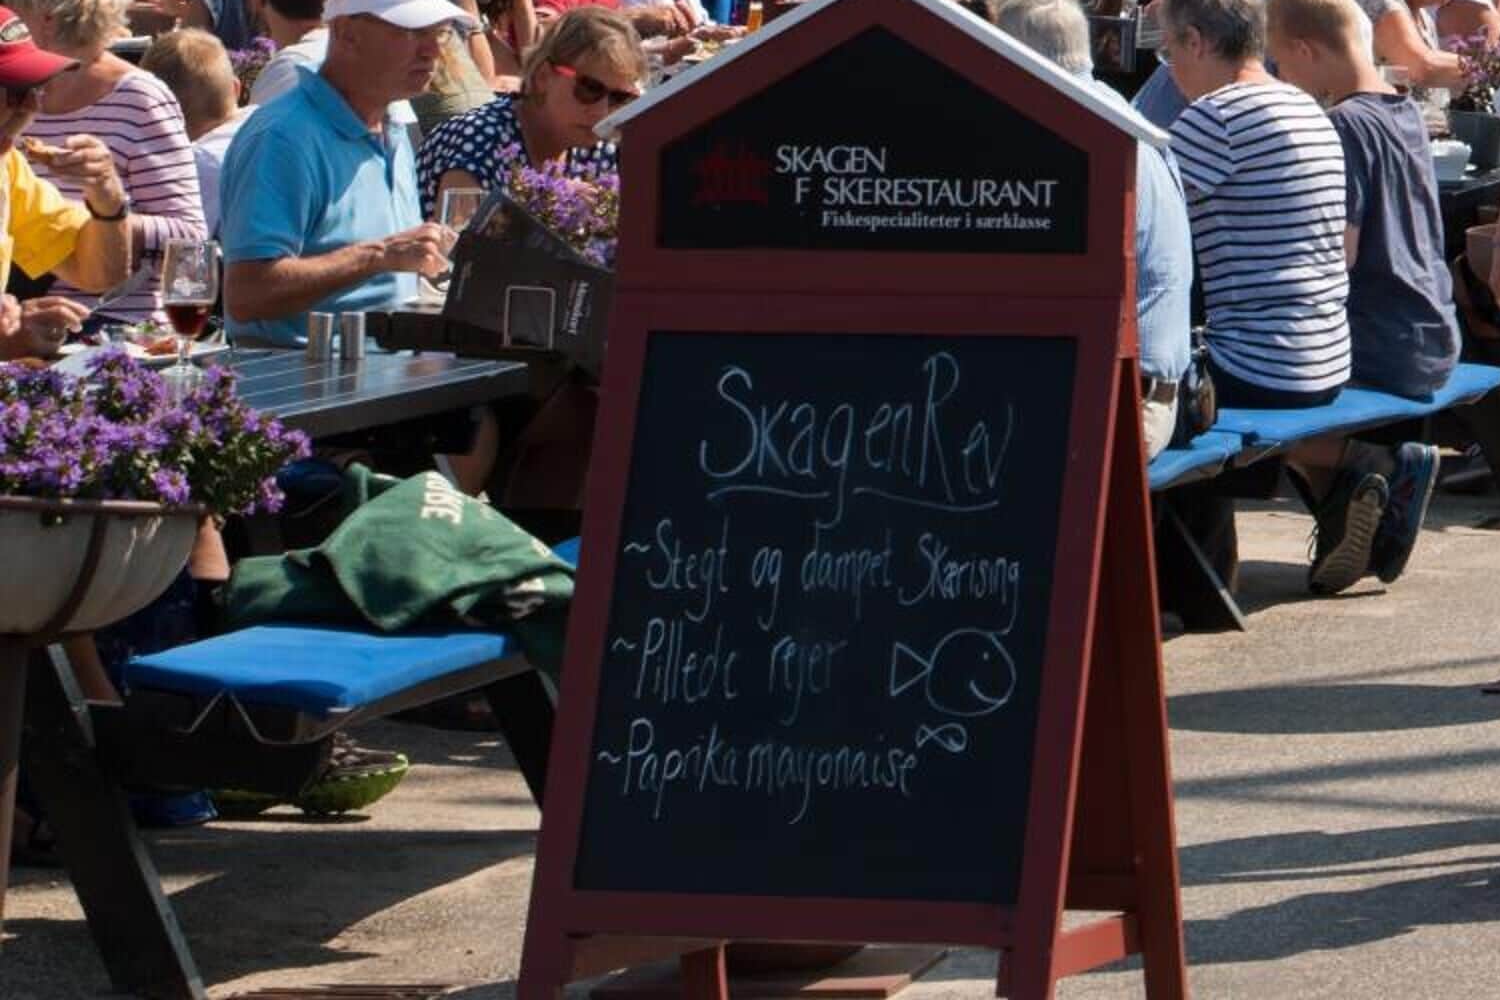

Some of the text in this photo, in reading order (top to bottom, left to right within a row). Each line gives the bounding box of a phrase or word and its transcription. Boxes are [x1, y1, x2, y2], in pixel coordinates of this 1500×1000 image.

[775, 144, 887, 175] SKAGEN
[821, 210, 1051, 232] Fiskespecialiteter i særklasse
[751, 546, 783, 633] og
[800, 520, 892, 621] dampet
[767, 635, 849, 728] rejer
